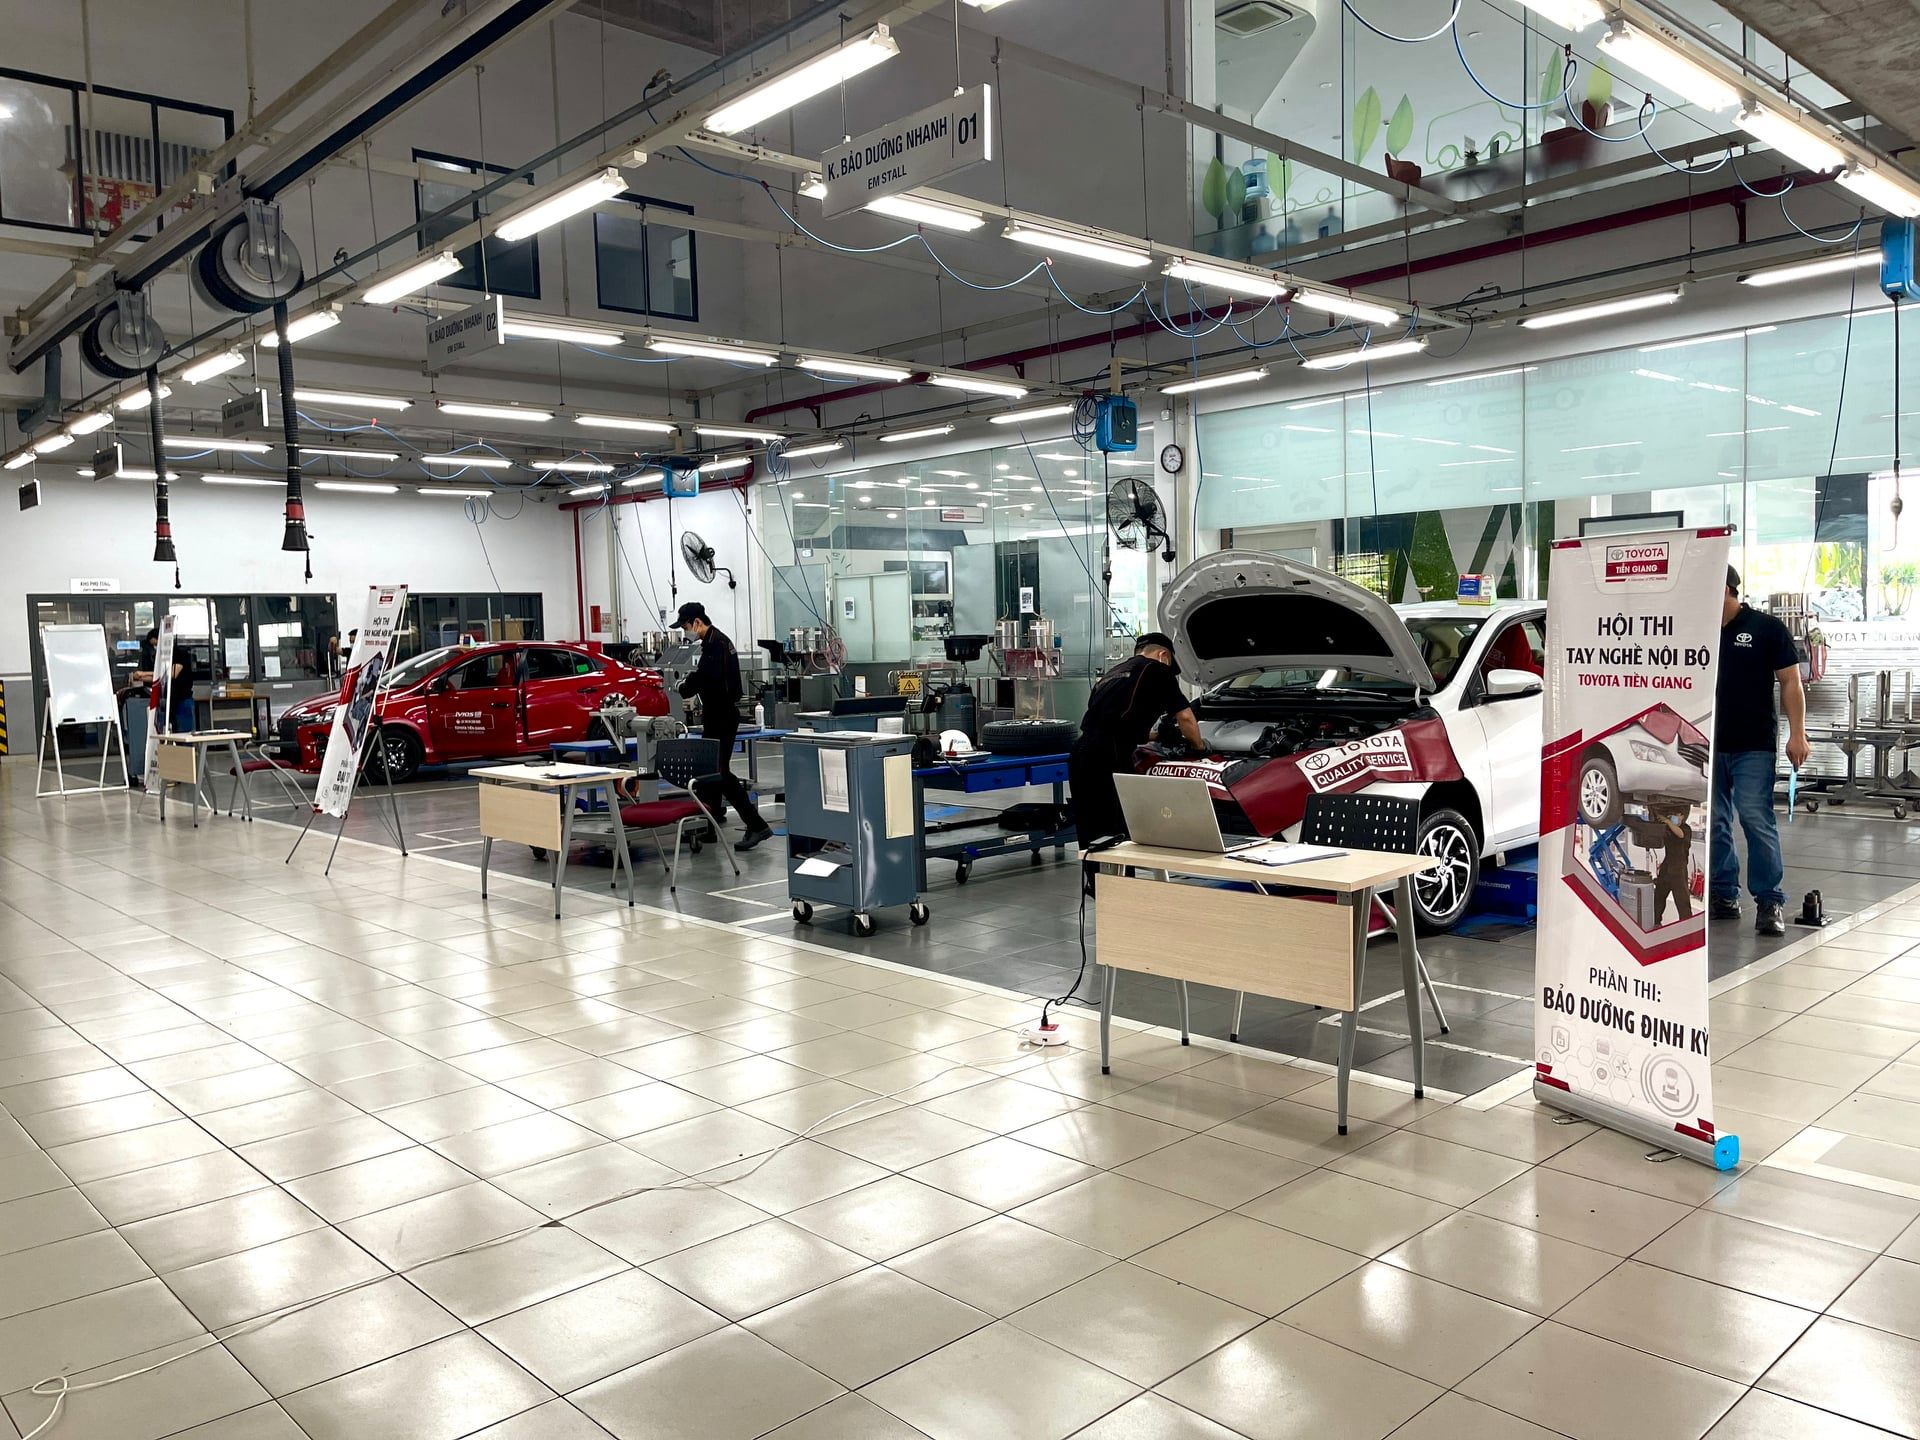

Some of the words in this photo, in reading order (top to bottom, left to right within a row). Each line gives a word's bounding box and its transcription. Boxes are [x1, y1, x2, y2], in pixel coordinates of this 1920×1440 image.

[840, 150, 862, 176] BẢO
[865, 135, 902, 166] DƯỠNG
[906, 116, 947, 150] NHANH
[958, 112, 977, 145] 01
[868, 176, 880, 190] EM
[882, 165, 907, 184] STALL
[486, 312, 496, 332] 02
[1624, 548, 1664, 558] TOYOTA
[1632, 564, 1658, 573] GIANG
[1598, 612, 1633, 641] HỘI
[1640, 616, 1673, 636] THI
[1826, 632, 1857, 642] YOTA
[1566, 648, 1595, 664] TAY
[1599, 643, 1643, 665] NGHỀ
[1648, 645, 1678, 670] NỘI
[1684, 645, 1710, 670] BỘ
[1578, 674, 1620, 687] TOYOTA
[1623, 672, 1648, 688] TIỀN
[1652, 676, 1692, 690] GIANG
[1336, 736, 1402, 756] TOYOTA
[1152, 766, 1189, 776] QUALITY
[1317, 756, 1365, 785] QUALITY
[1365, 754, 1406, 765] SERVICE
[1590, 966, 1628, 994] PHẦN
[1634, 978, 1661, 1003] THI:
[1543, 984, 1575, 1015] BẢO
[1580, 996, 1635, 1034] DƯỠNG
[1641, 1014, 1684, 1047] ĐỊNH
[1691, 1027, 1709, 1057] KỲ
